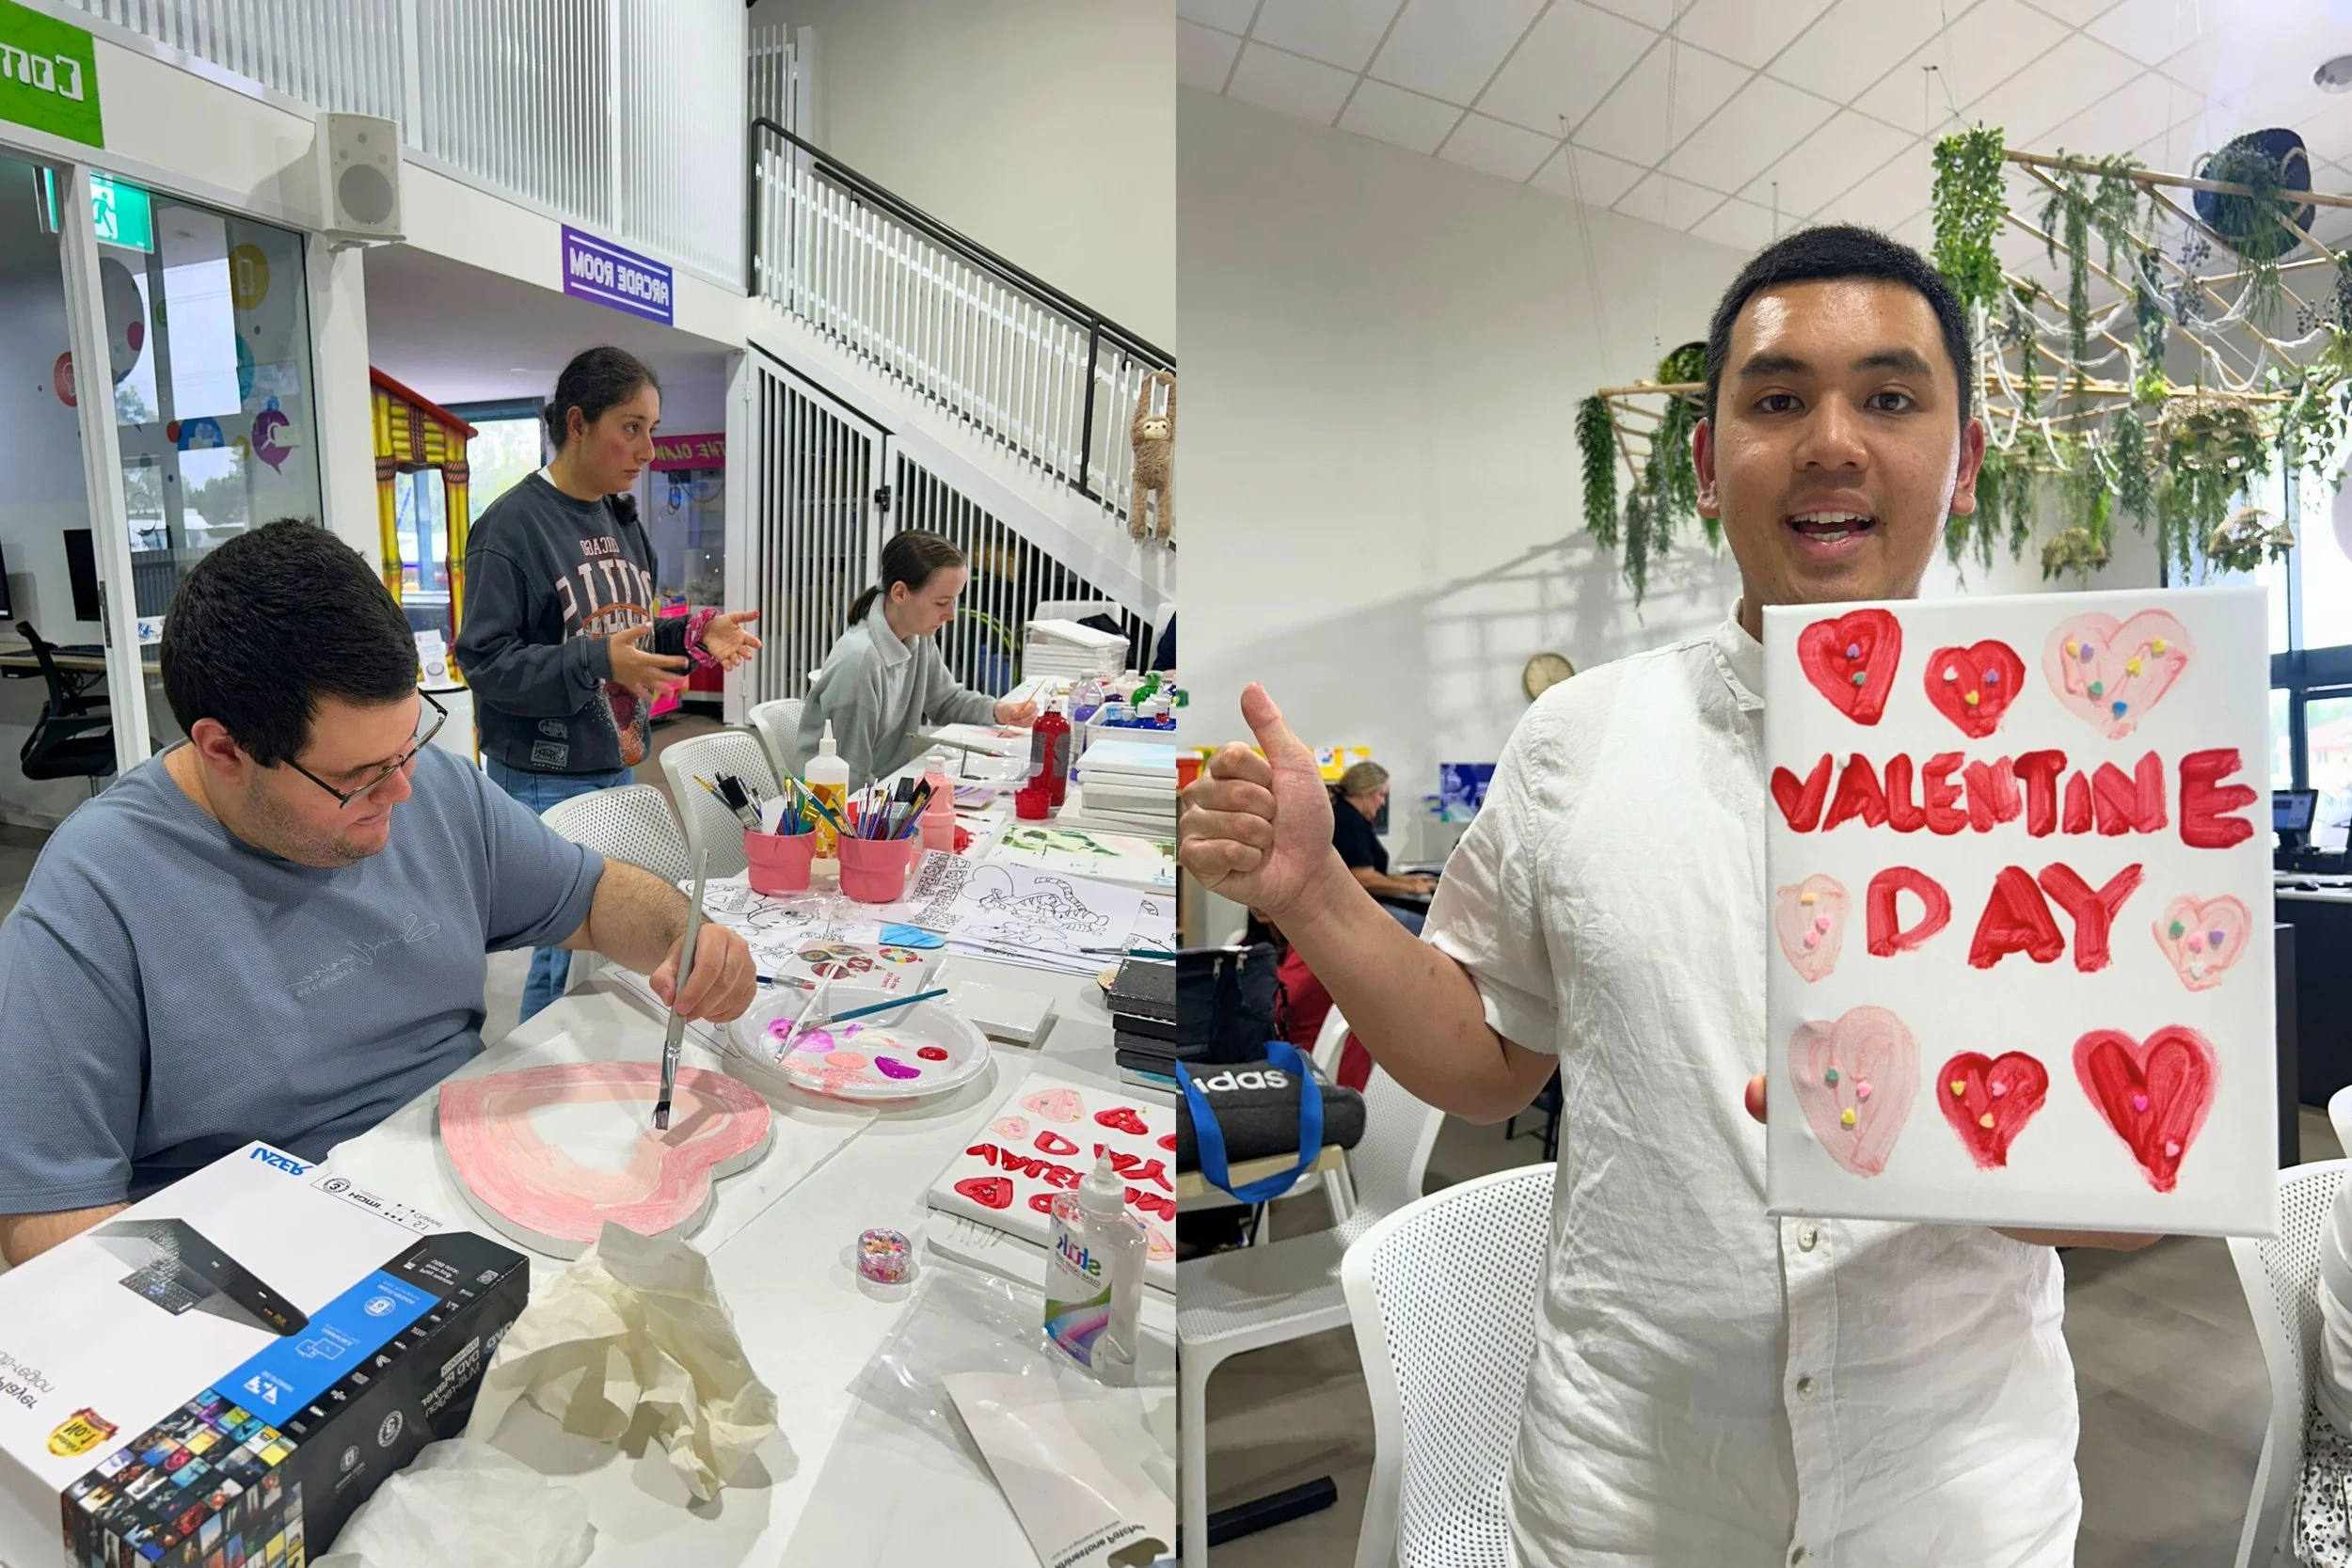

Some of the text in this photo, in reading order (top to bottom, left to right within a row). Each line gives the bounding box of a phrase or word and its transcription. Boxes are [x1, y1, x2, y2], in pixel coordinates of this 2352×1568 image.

[1771, 748, 2257, 849] VALENTINE
[1867, 862, 2144, 973] DAY
[1176, 1069, 1289, 1095] idas
